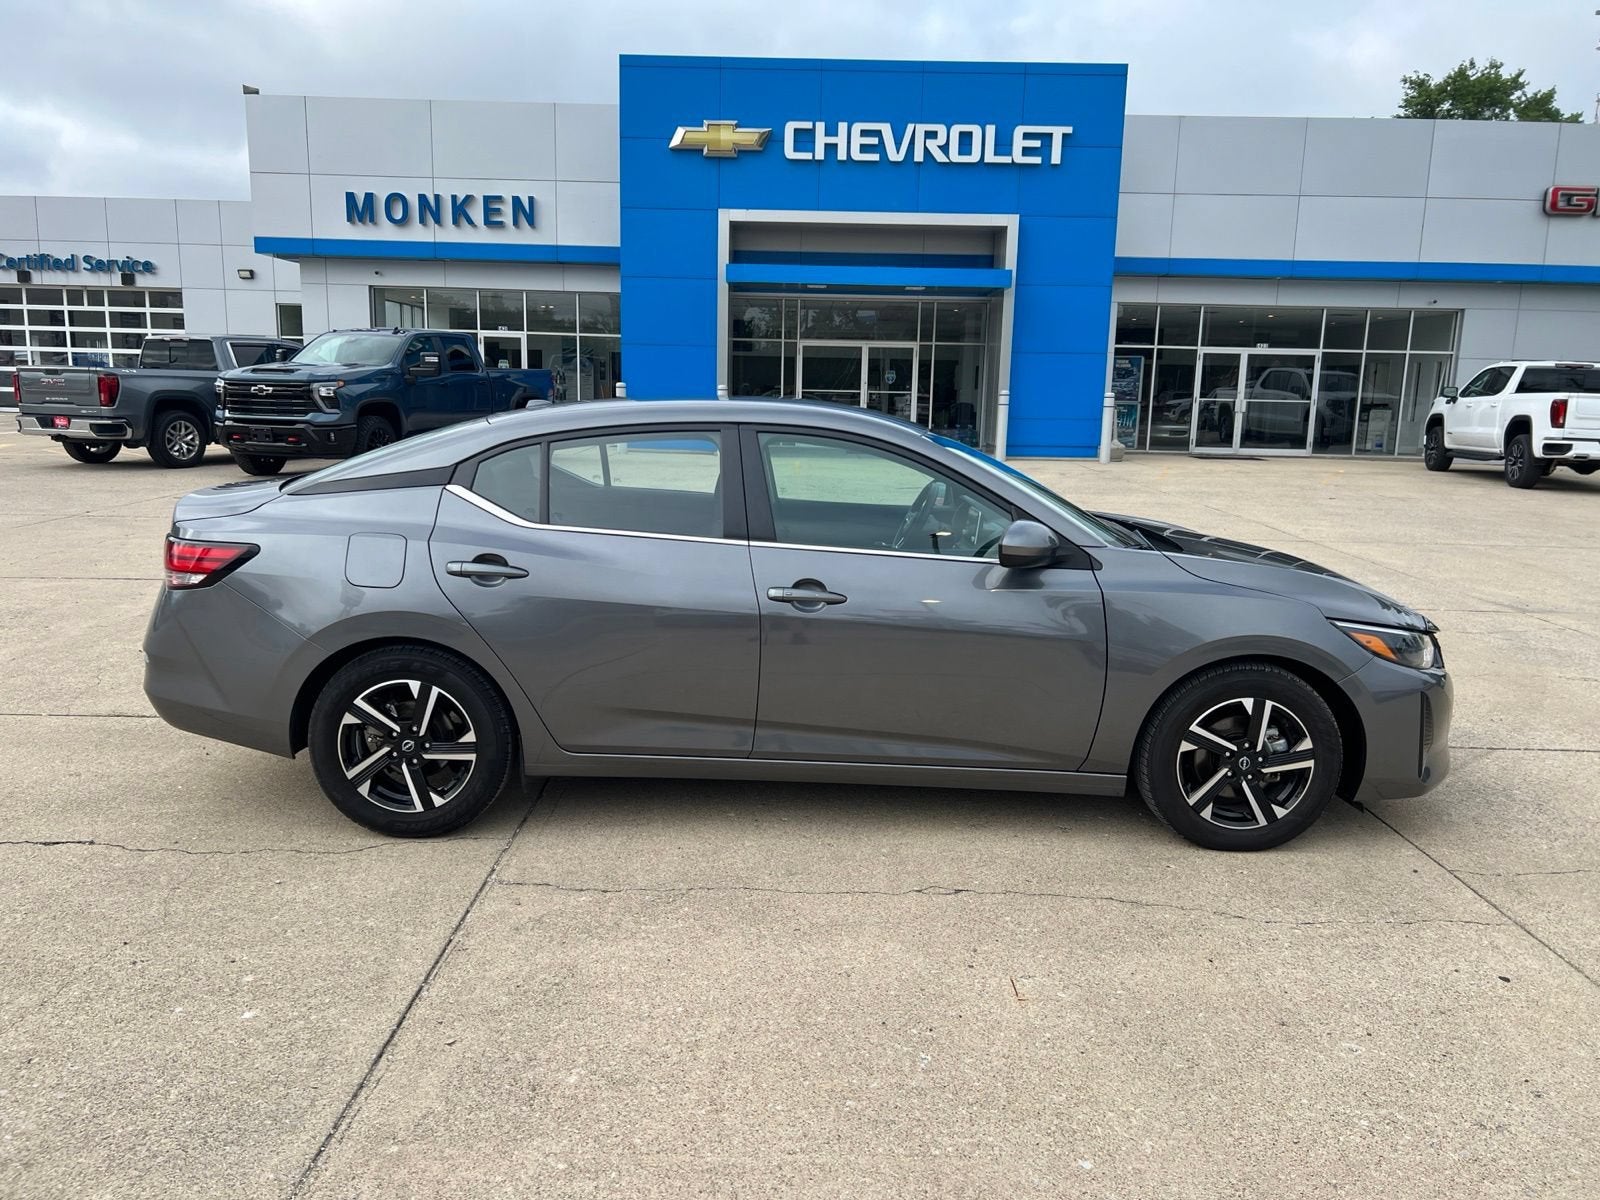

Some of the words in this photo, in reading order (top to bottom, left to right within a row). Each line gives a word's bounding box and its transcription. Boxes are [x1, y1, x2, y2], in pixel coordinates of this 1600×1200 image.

[784, 121, 1073, 164] CHEVROLET
[345, 191, 537, 228] MONKEN
[1543, 185, 1600, 217] G
[83, 255, 155, 273] Service
